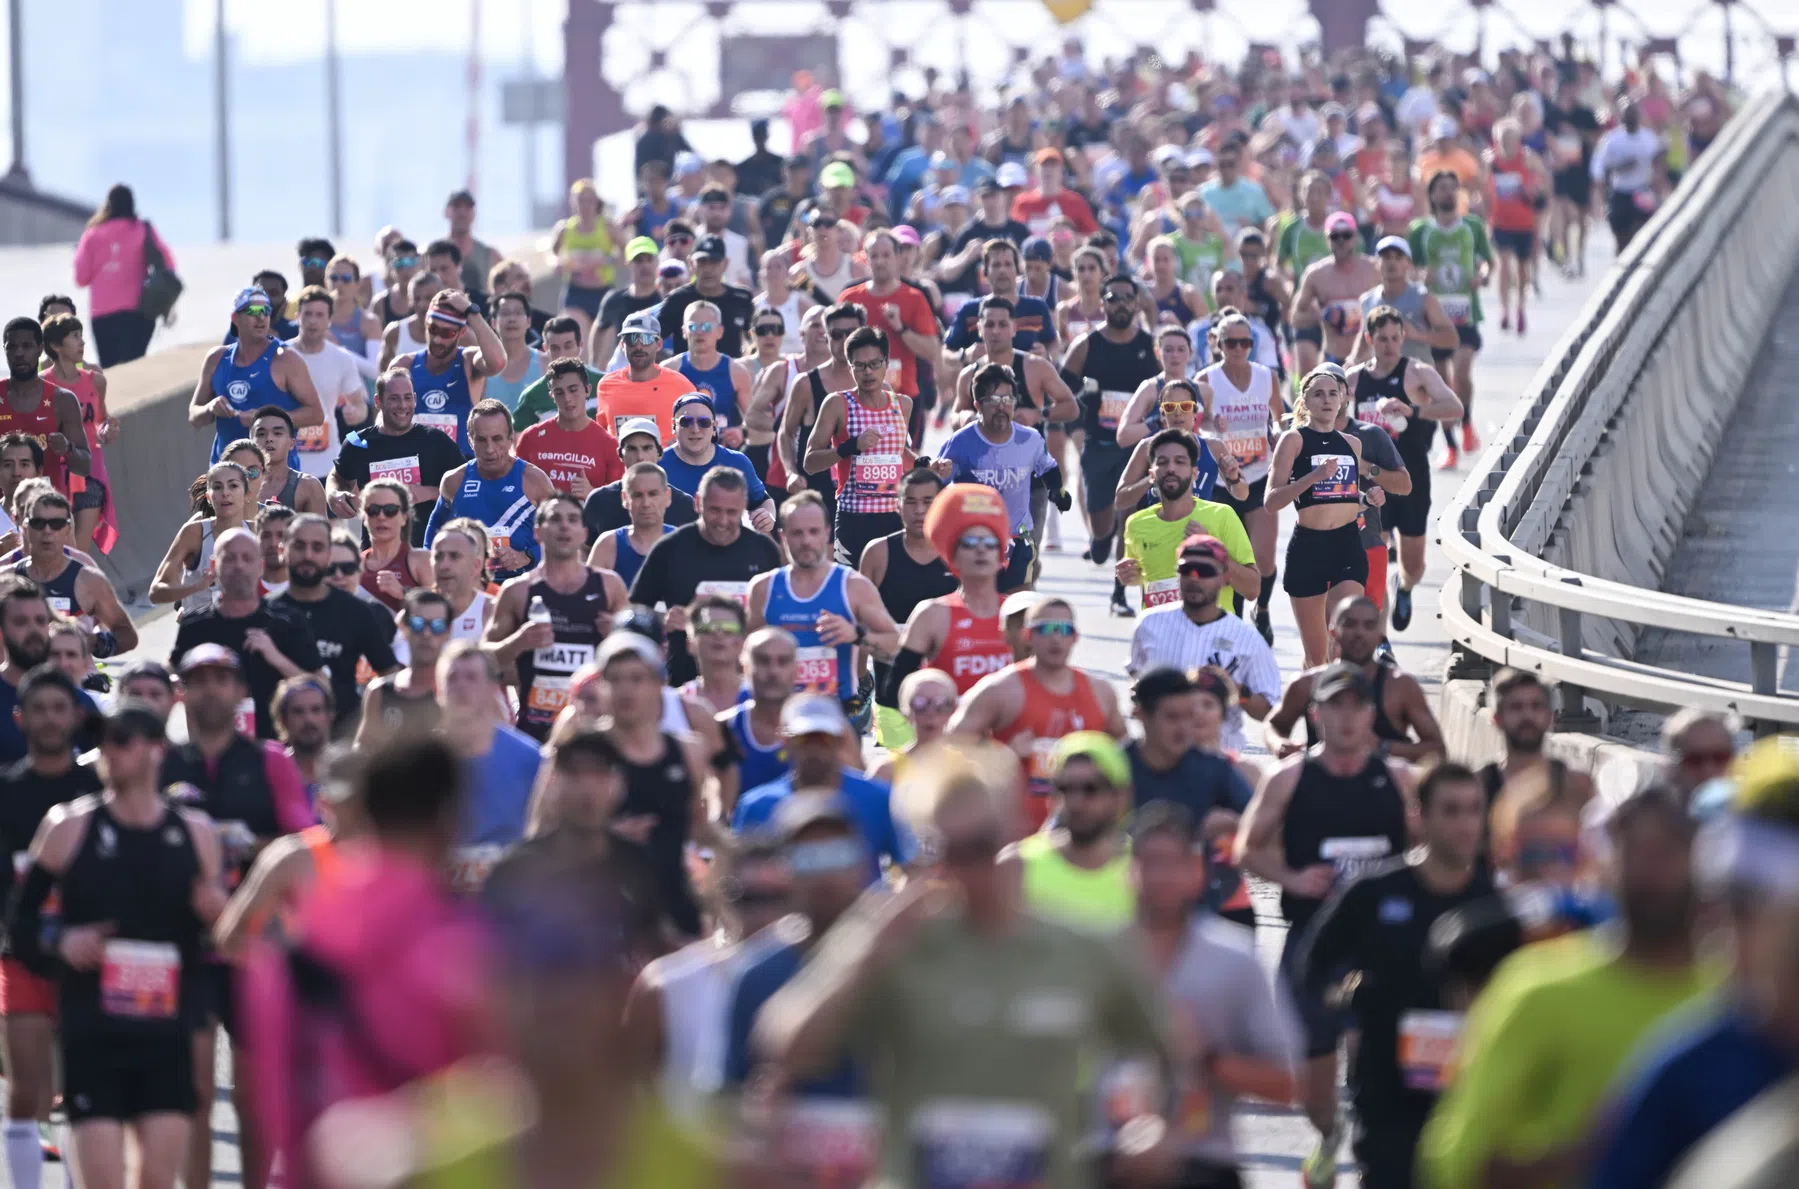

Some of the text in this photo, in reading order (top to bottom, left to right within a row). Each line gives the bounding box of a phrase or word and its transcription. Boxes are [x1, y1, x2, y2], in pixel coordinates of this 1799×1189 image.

[1220, 404, 1249, 413] TEAM
[538, 452, 596, 467] teamGILDA
[550, 470, 577, 481] SAM
[863, 466, 897, 480] 8988
[984, 468, 1019, 486] RUN
[540, 650, 587, 664] MATT
[797, 660, 830, 678] 063
